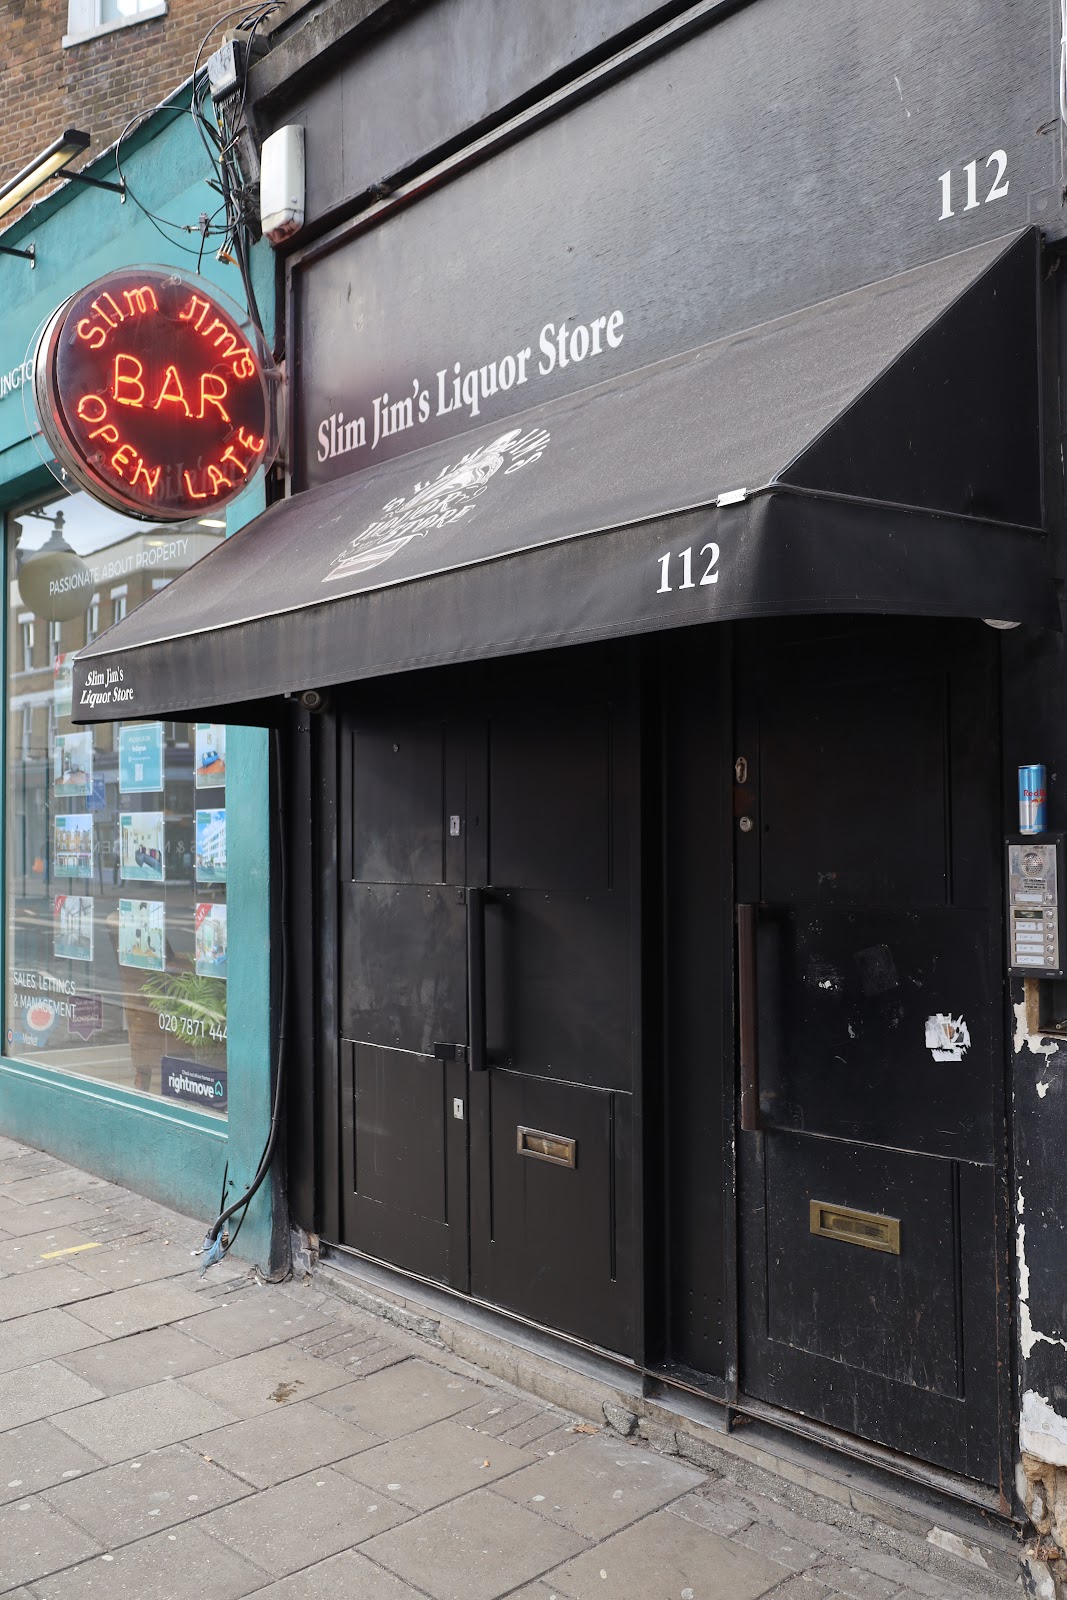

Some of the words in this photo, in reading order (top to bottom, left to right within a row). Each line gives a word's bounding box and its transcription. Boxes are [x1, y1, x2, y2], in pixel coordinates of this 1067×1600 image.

[938, 149, 1010, 221] 112
[112, 354, 231, 422] BAR
[317, 411, 366, 463] Slim
[371, 378, 430, 450] Jim's
[436, 347, 531, 417] Liquor
[538, 309, 624, 375] Store
[78, 395, 162, 495] OPEN
[184, 426, 264, 498] LATE
[49, 567, 100, 596] PASSIONATE
[102, 556, 134, 580] ABOUT
[136, 537, 189, 569] PROPERTY
[656, 542, 720, 594] 112
[85, 670, 105, 687] Slim
[105, 666, 124, 688] Jim's
[80, 690, 111, 708] Liquor
[112, 686, 134, 702] Store
[13, 971, 38, 990] SALES,
[39, 976, 76, 995] LETTINGS
[14, 993, 19, 1007] &
[20, 994, 77, 1019] MANAGEMENT
[158, 1013, 178, 1032] 020
[181, 1017, 205, 1038] 7871
[168, 1073, 215, 1098] rightmove
